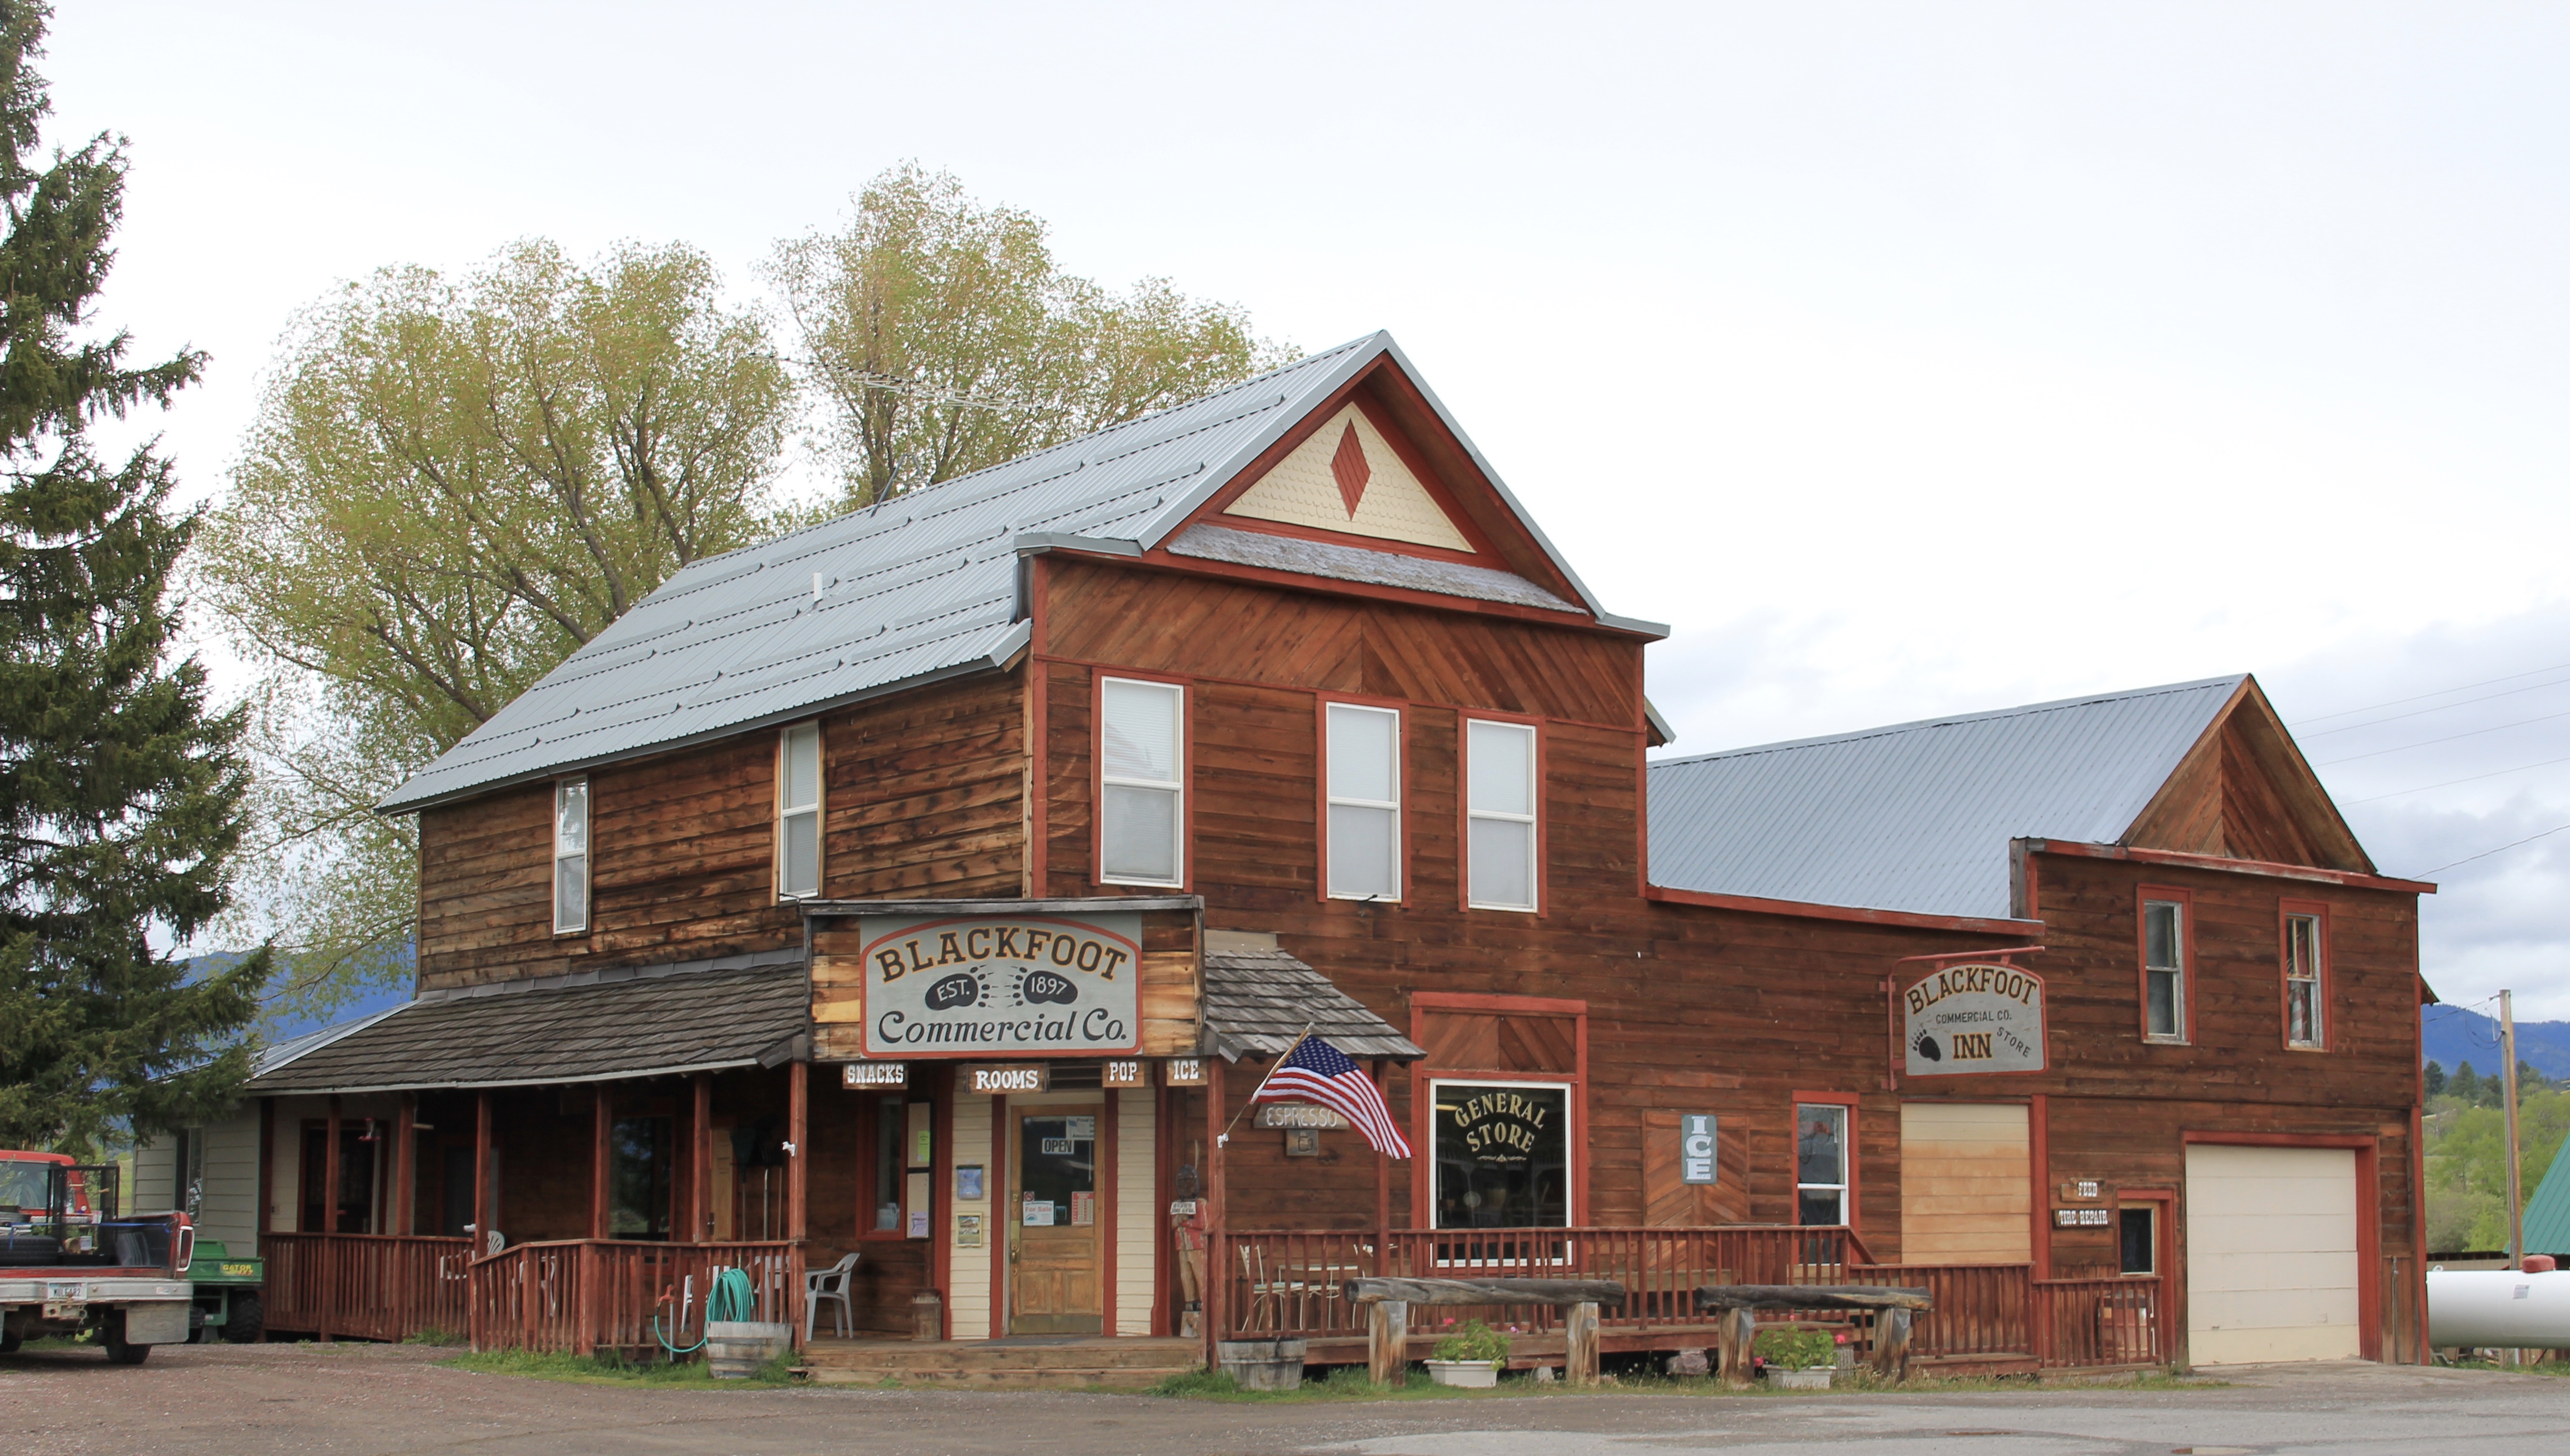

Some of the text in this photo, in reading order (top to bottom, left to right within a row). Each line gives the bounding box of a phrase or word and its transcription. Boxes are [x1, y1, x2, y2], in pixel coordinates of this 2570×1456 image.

[874, 926, 1128, 983] BLACKFOOT
[936, 977, 1067, 1002] EST. 1897
[1906, 967, 2038, 1016] BLACKFOOT
[878, 1007, 1127, 1043] Commercial Co.
[1936, 1010, 2012, 1024] COMMERCIAL CO.
[1953, 1033, 1993, 1059] INN
[1997, 1027, 2031, 1058] STORE
[847, 1064, 905, 1084] SNACKS
[975, 1070, 1039, 1090] ROOMS
[1109, 1061, 1137, 1081] POP
[1173, 1059, 1199, 1080] ICE
[1266, 1107, 1337, 1128] ESPRESSO
[1455, 1093, 1546, 1129] GENERAL
[1044, 1139, 1072, 1153] OPEN
[1466, 1121, 1535, 1153] STORE
[1686, 1116, 1712, 1179] ICE
[2078, 1182, 2097, 1197] FEED
[2058, 1209, 2108, 1225] TIRE REPAIR
